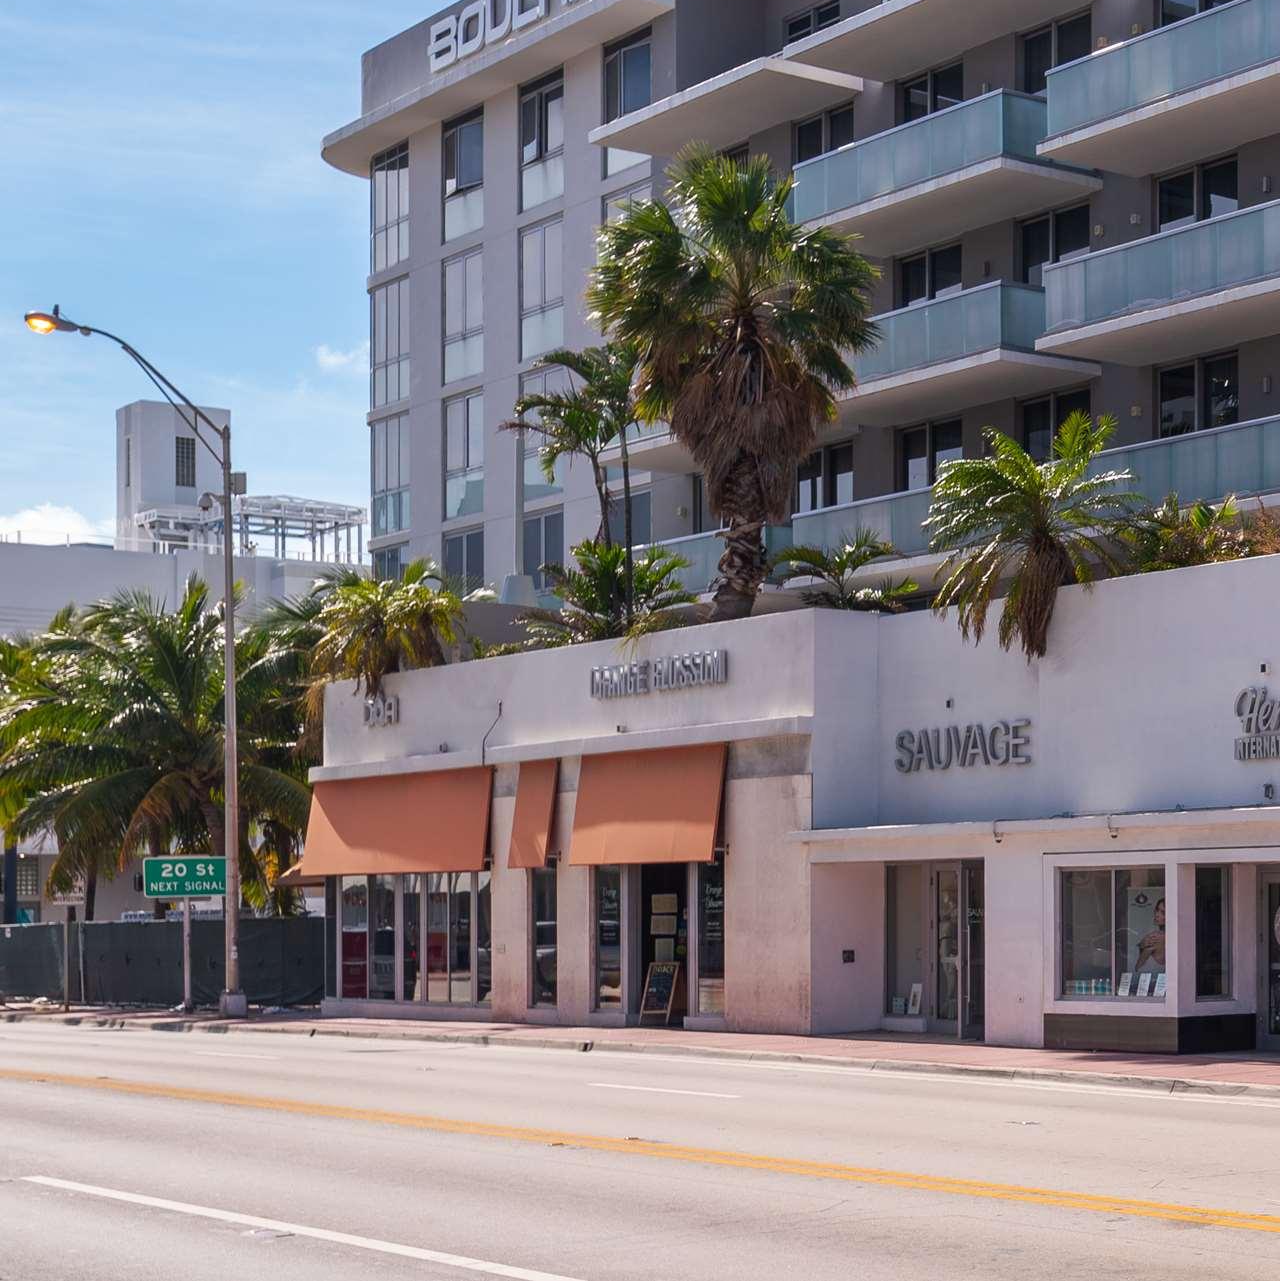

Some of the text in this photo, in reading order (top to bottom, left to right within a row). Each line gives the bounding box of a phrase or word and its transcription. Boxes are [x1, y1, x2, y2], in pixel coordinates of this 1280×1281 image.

[895, 718, 1032, 773] SAUVAGE
[161, 863, 215, 877] 20 St
[150, 880, 225, 892] NEXT SIGNAL
